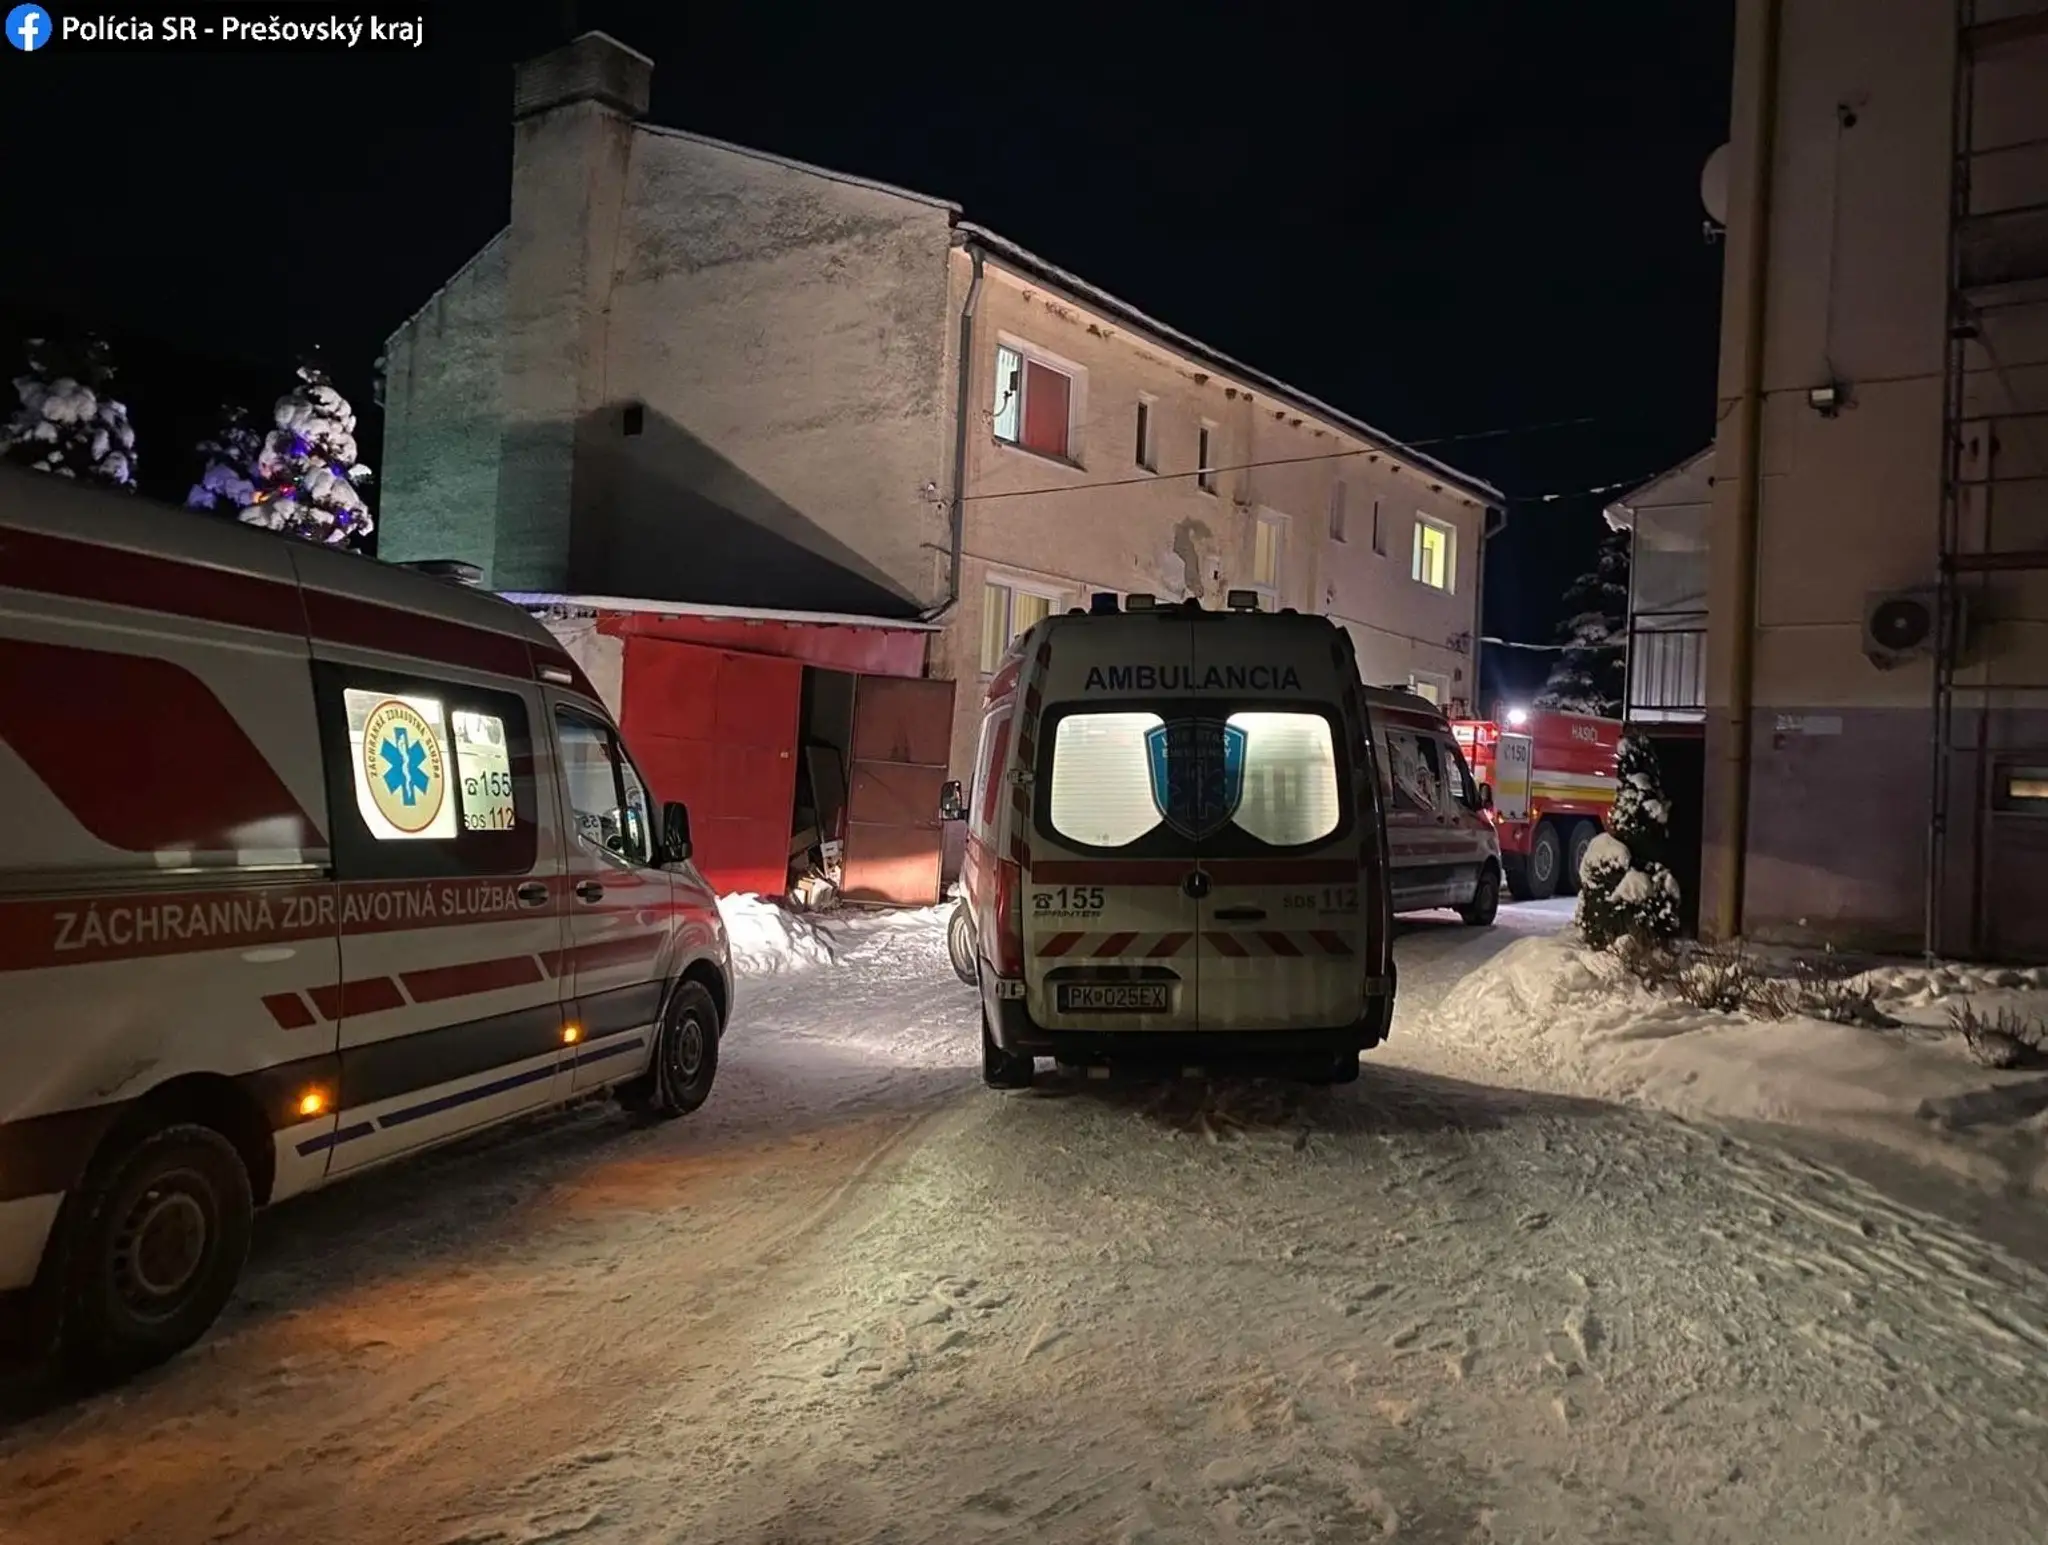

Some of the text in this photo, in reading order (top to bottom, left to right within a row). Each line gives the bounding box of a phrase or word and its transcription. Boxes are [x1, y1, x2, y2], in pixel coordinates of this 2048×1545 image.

[1085, 664, 1303, 692] AMBULANCIA
[1511, 744, 1527, 762] 150
[480, 770, 513, 797] 155
[463, 806, 516, 830] SOS 112
[1056, 886, 1106, 910] 155
[1321, 887, 1360, 909] 112
[53, 880, 520, 951] ZÁCHRANNÁ ZDRAVOTNÁ SLUŽBA
